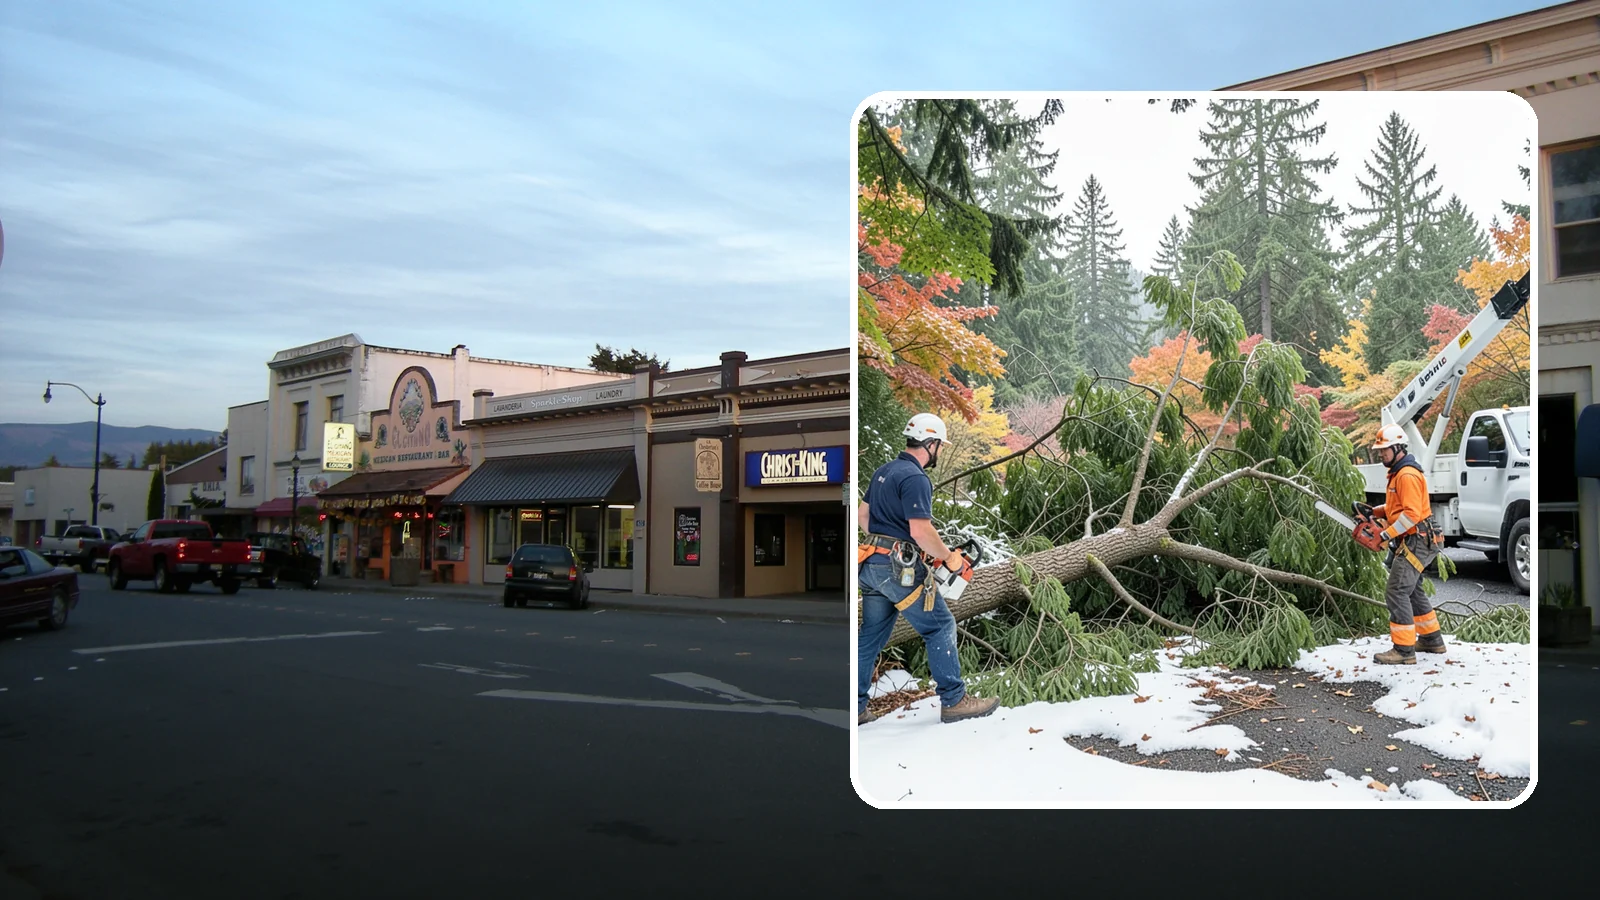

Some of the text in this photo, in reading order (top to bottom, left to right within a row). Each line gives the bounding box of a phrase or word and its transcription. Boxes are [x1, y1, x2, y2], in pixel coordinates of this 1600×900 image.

[562, 394, 582, 406] Shop
[595, 389, 624, 400] LAUNDRY
[493, 402, 523, 412] LAVANDERIA
[373, 455, 396, 464] MEXICAN
[397, 451, 433, 462] RESTAURANT
[438, 450, 450, 458] BAR
[761, 450, 827, 478] CHRIST KING
